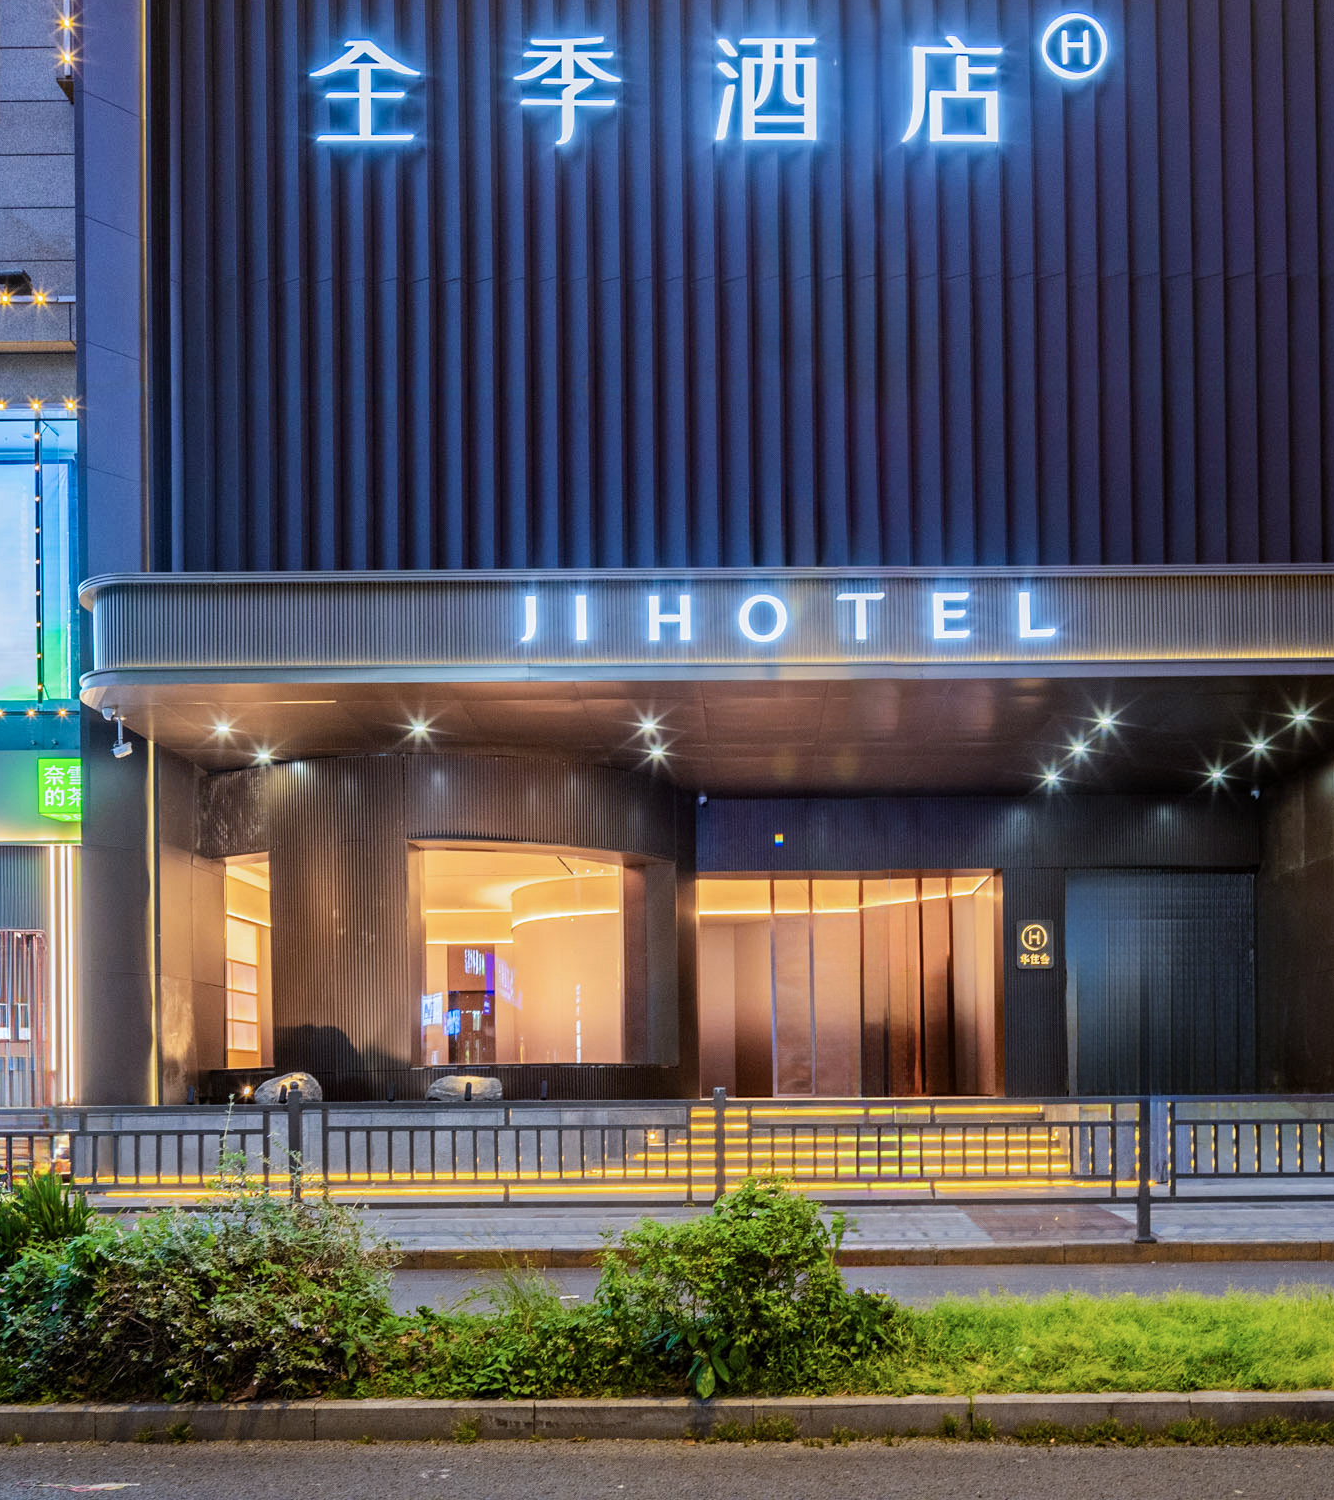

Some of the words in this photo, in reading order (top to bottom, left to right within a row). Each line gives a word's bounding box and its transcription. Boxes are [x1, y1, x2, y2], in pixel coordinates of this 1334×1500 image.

[309, 34, 1004, 145] 全季酒店
[521, 594, 588, 642] JI
[648, 591, 1057, 644] HOTEL
